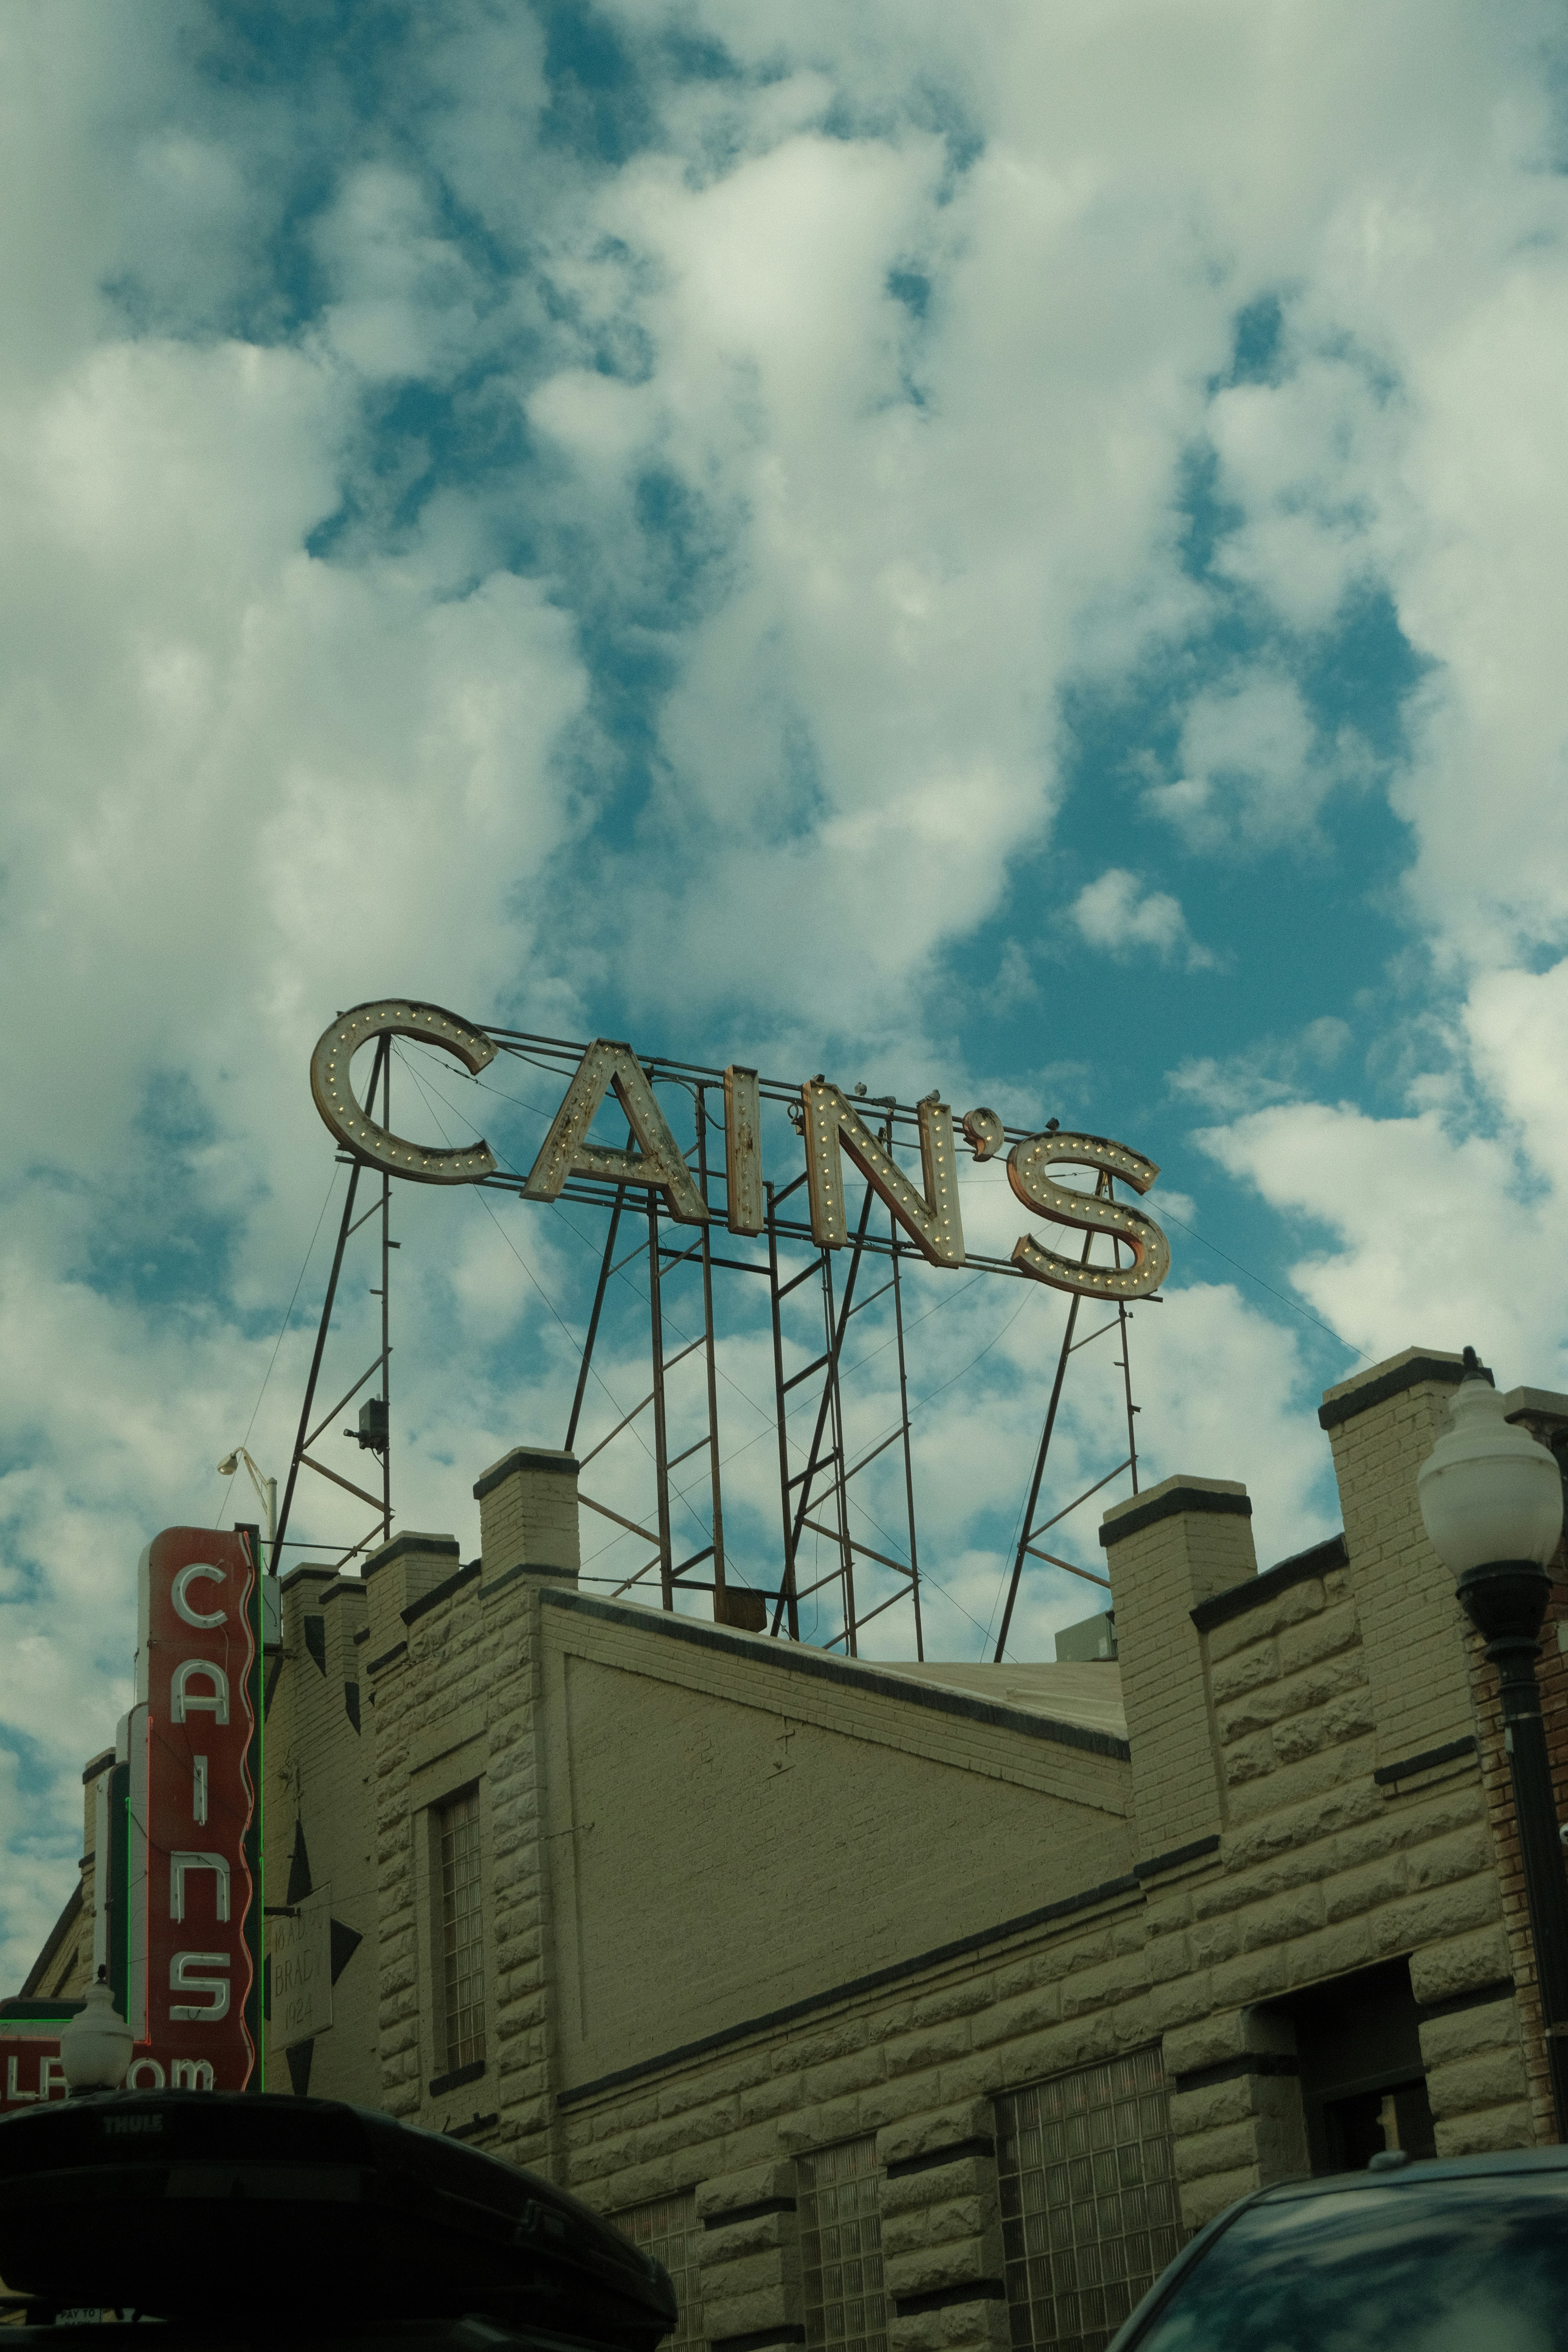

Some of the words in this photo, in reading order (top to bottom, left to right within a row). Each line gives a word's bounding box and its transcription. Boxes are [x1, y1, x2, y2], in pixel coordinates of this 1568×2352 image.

[310, 999, 1170, 1300] CAIN'S
[103, 2113, 163, 2133] THULE
[61, 2309, 79, 2319] PAY
[84, 2309, 95, 2317] TO
